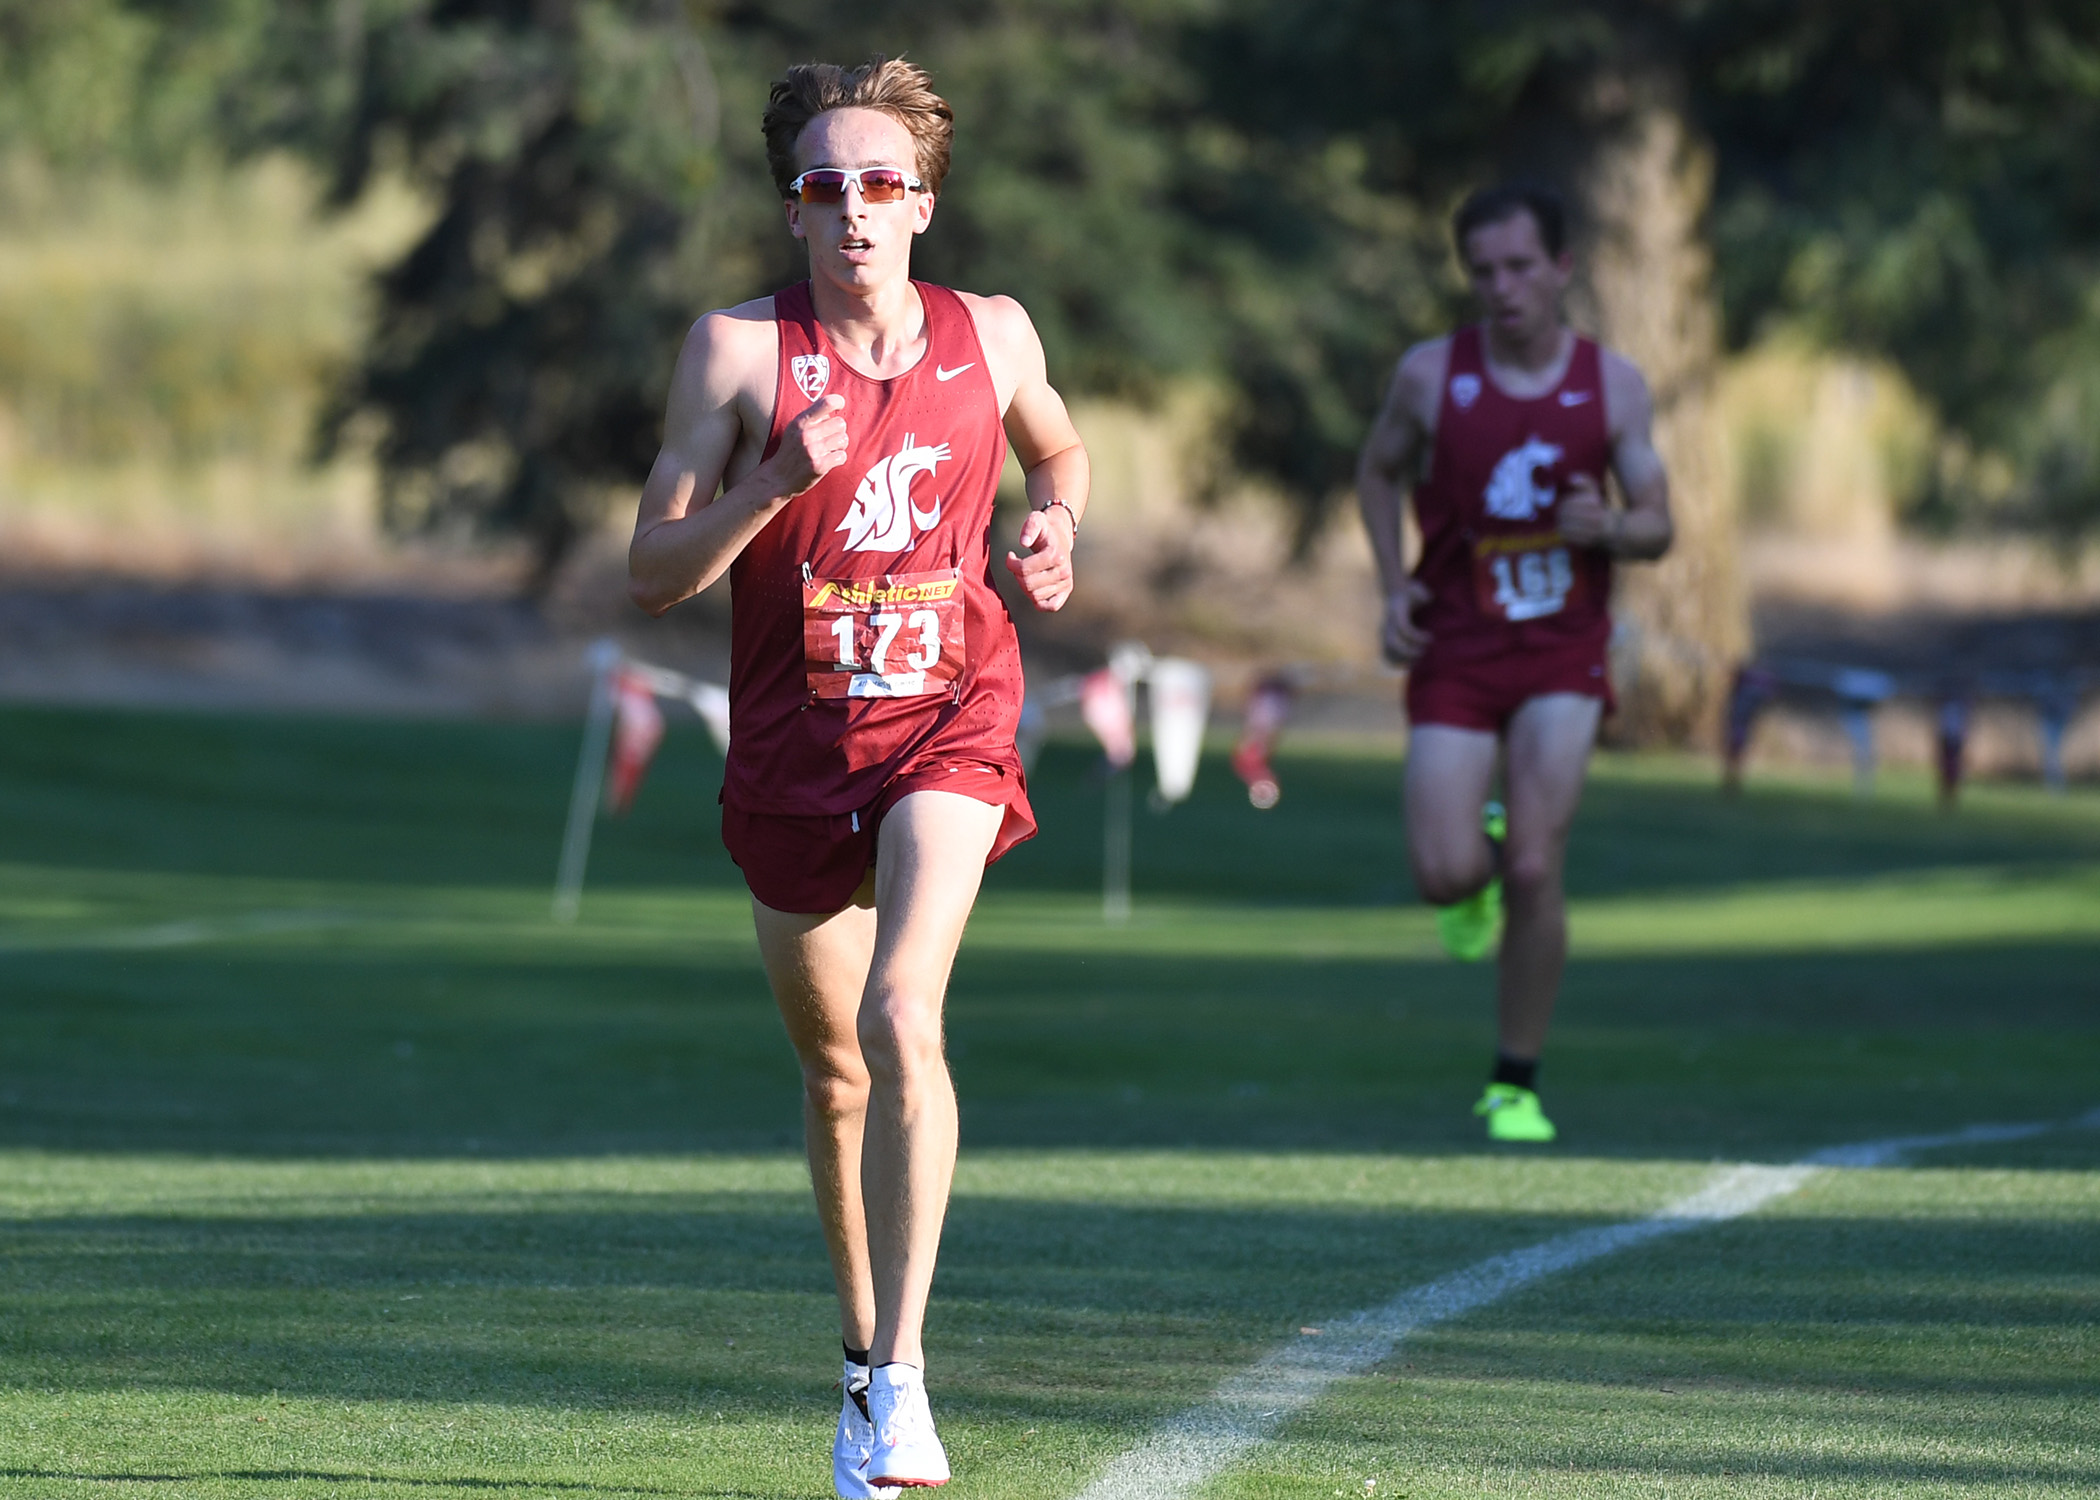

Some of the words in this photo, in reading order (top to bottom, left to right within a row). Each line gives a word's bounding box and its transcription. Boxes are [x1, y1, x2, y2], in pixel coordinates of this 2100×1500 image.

[793, 356, 828, 383] PAC
[804, 374, 822, 391] 12
[831, 610, 941, 674] 173
